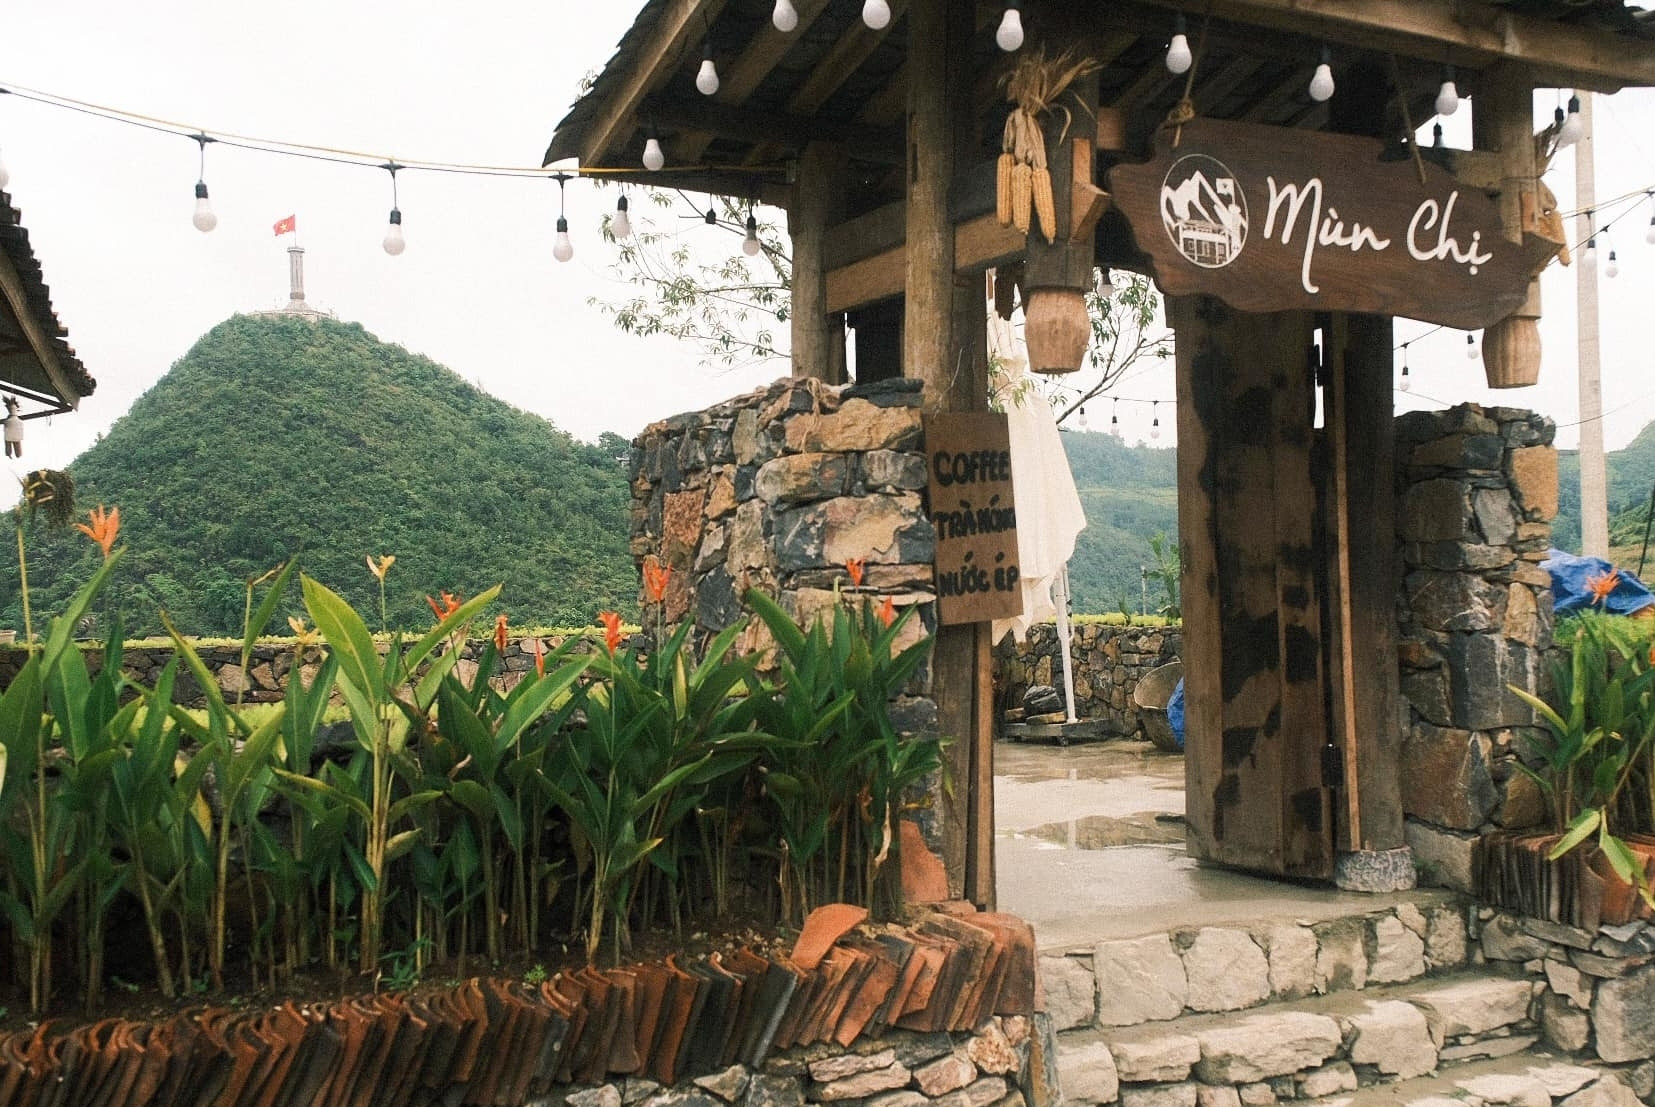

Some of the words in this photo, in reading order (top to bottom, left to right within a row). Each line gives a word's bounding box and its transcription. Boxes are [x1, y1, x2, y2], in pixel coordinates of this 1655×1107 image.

[1263, 176, 1390, 294] Mùn
[1406, 190, 1493, 276] Chị
[933, 450, 1010, 487] COFFEE
[934, 499, 977, 541] TRÀ
[938, 550, 991, 598] NƯỚC
[994, 551, 1019, 593] ÉP
